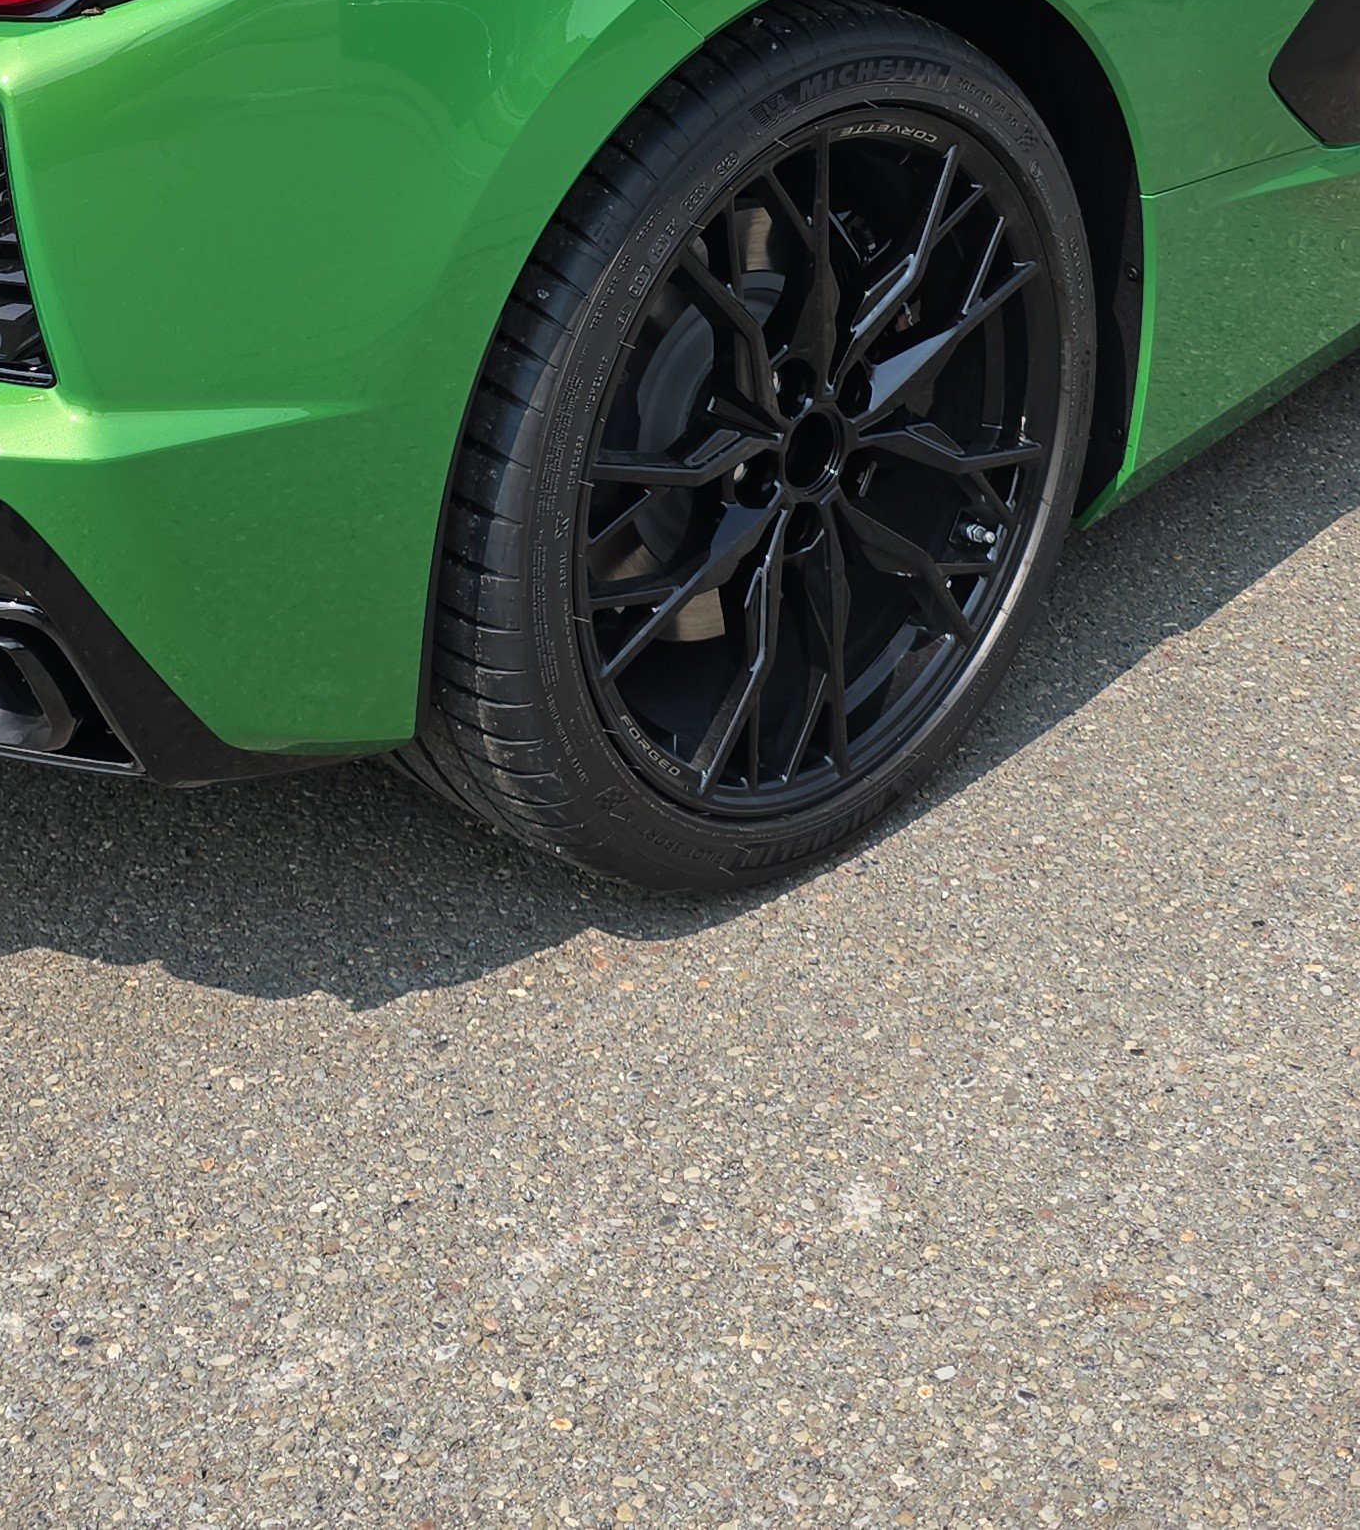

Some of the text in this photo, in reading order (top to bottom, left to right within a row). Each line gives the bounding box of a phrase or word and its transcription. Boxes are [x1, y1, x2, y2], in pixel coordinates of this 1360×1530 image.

[799, 58, 944, 104] MICHELIN
[839, 123, 938, 144] CORVETTE
[628, 264, 652, 298] DOT
[620, 714, 681, 777] FORGED
